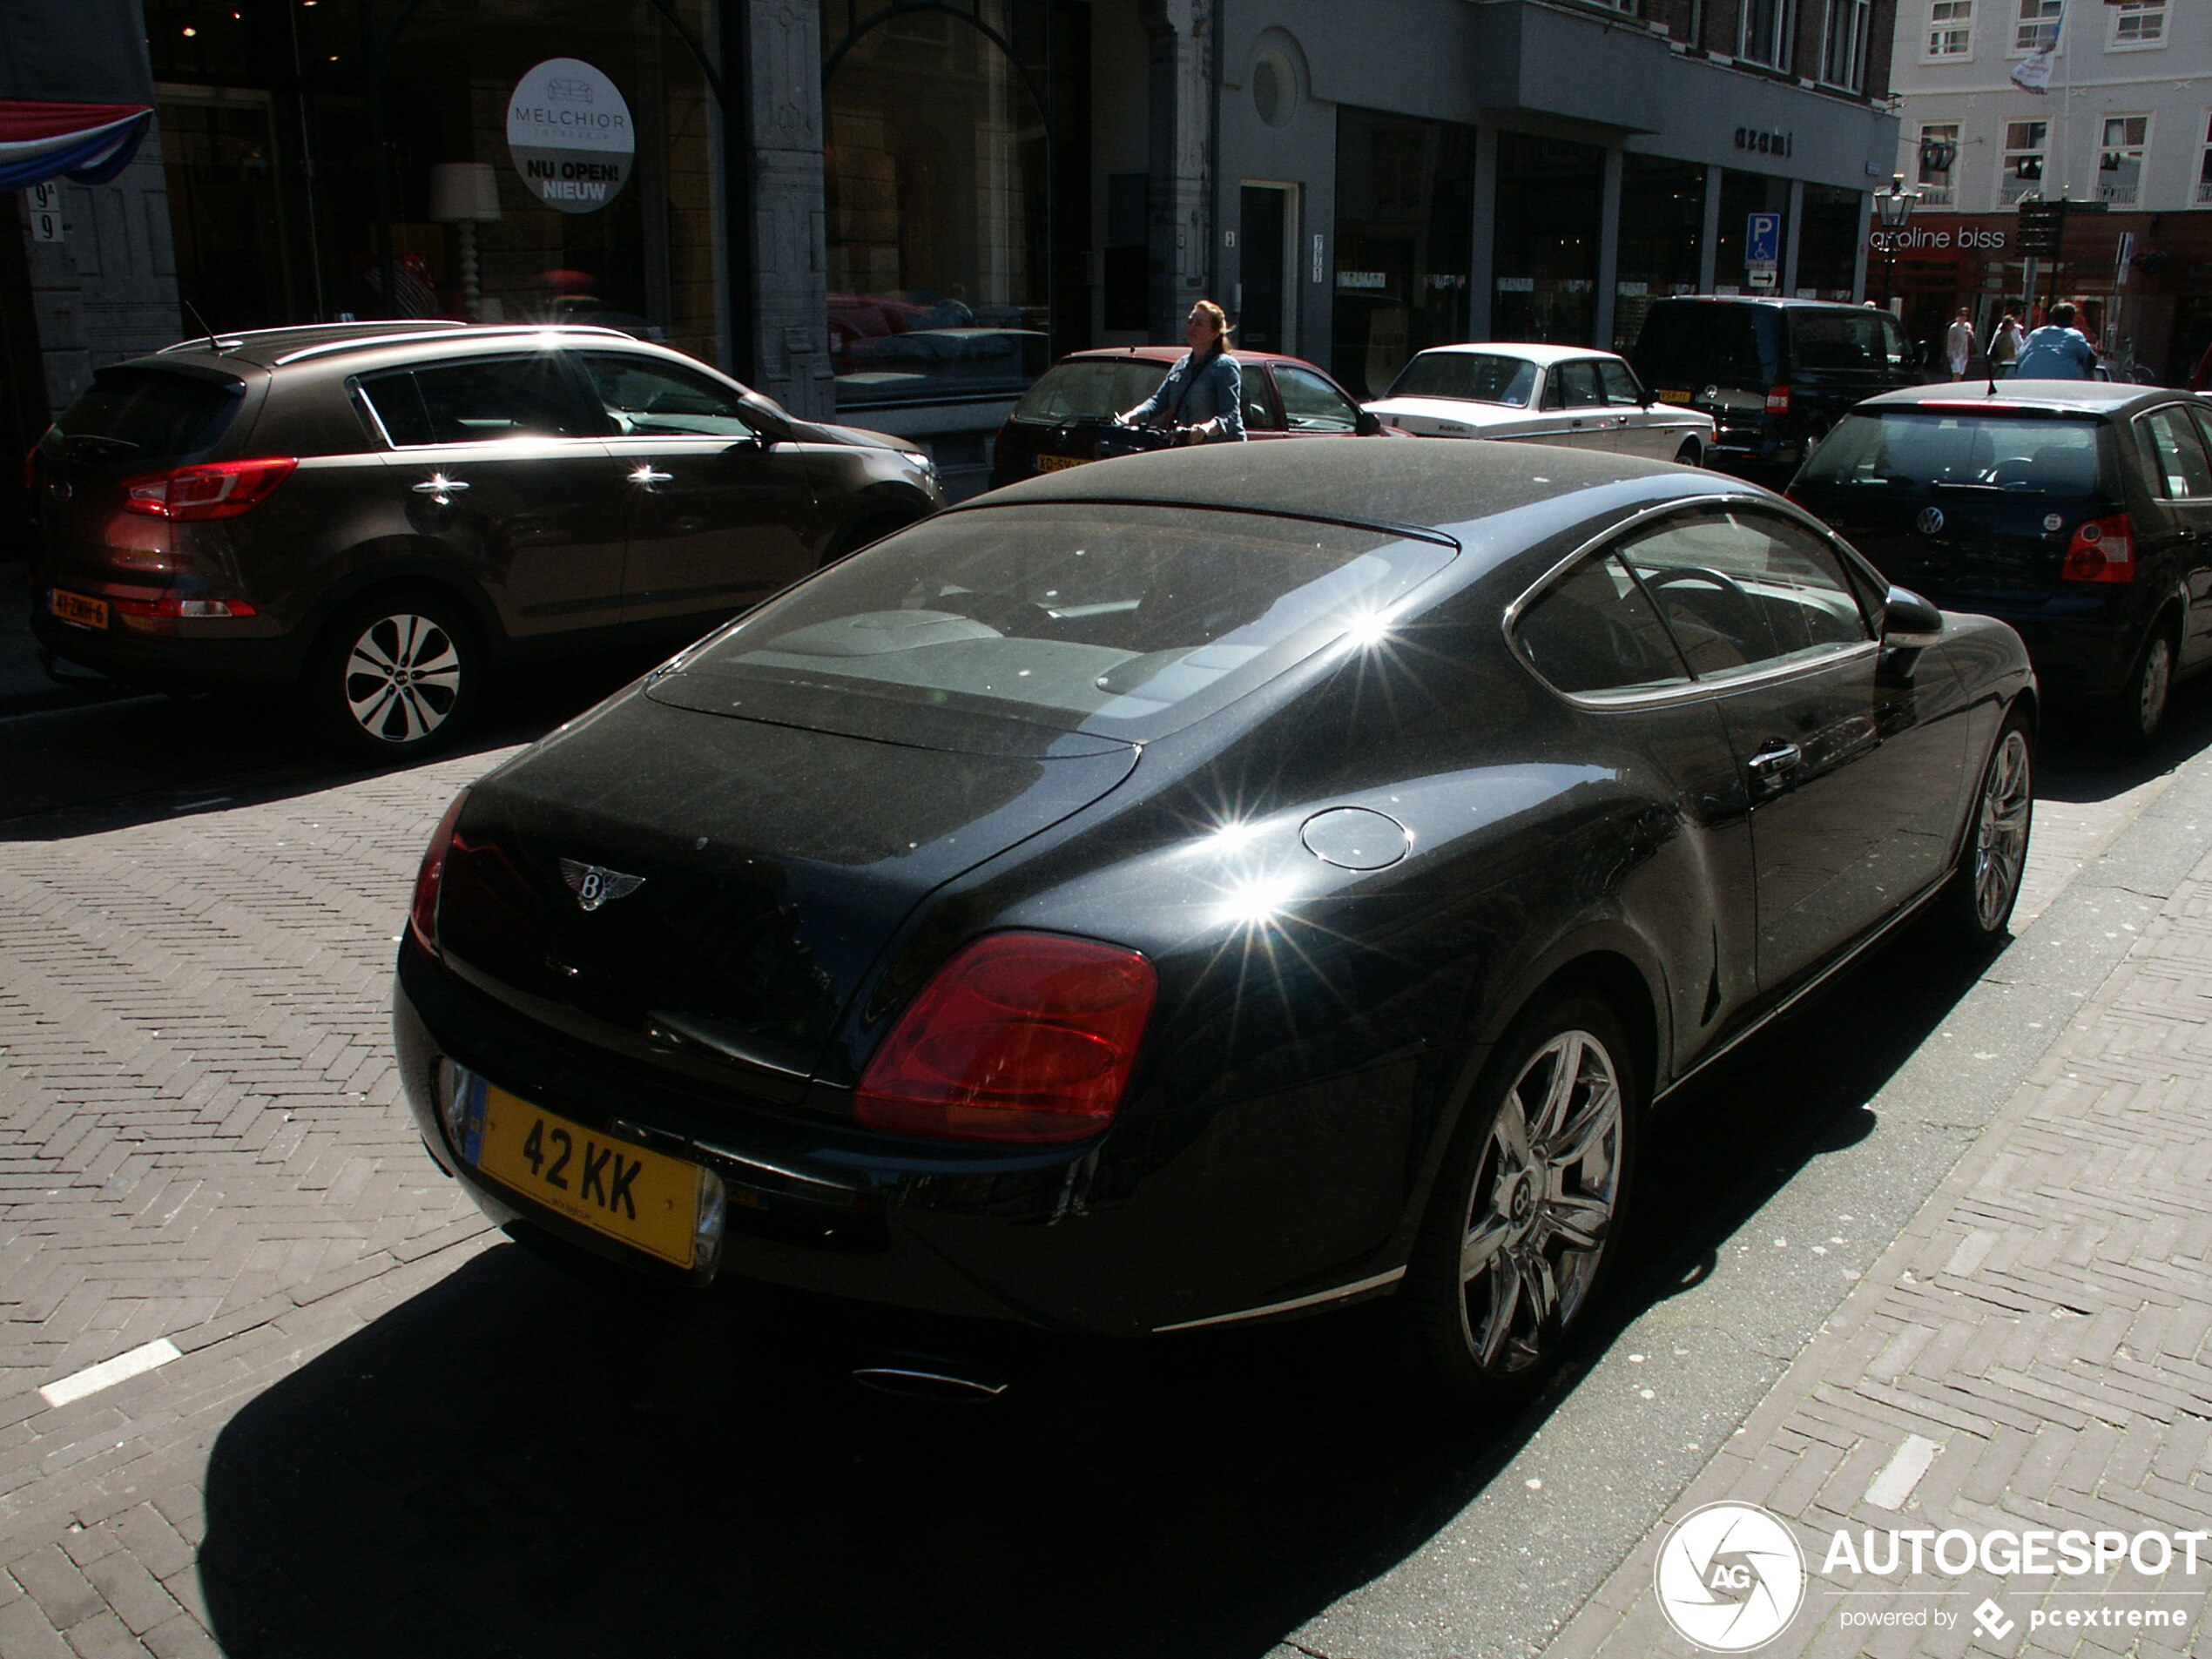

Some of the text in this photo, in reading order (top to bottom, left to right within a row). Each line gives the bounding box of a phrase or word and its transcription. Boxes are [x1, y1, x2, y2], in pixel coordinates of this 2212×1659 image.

[516, 107, 624, 128] MELCHIOR
[1735, 127, 1793, 158] azami
[528, 159, 618, 181] NU OPEN!
[543, 180, 607, 200] NIEUW
[43, 215, 53, 239] 9
[1753, 217, 1773, 242] P
[1958, 226, 2006, 248] biss
[523, 1118, 643, 1220] 42 KK
